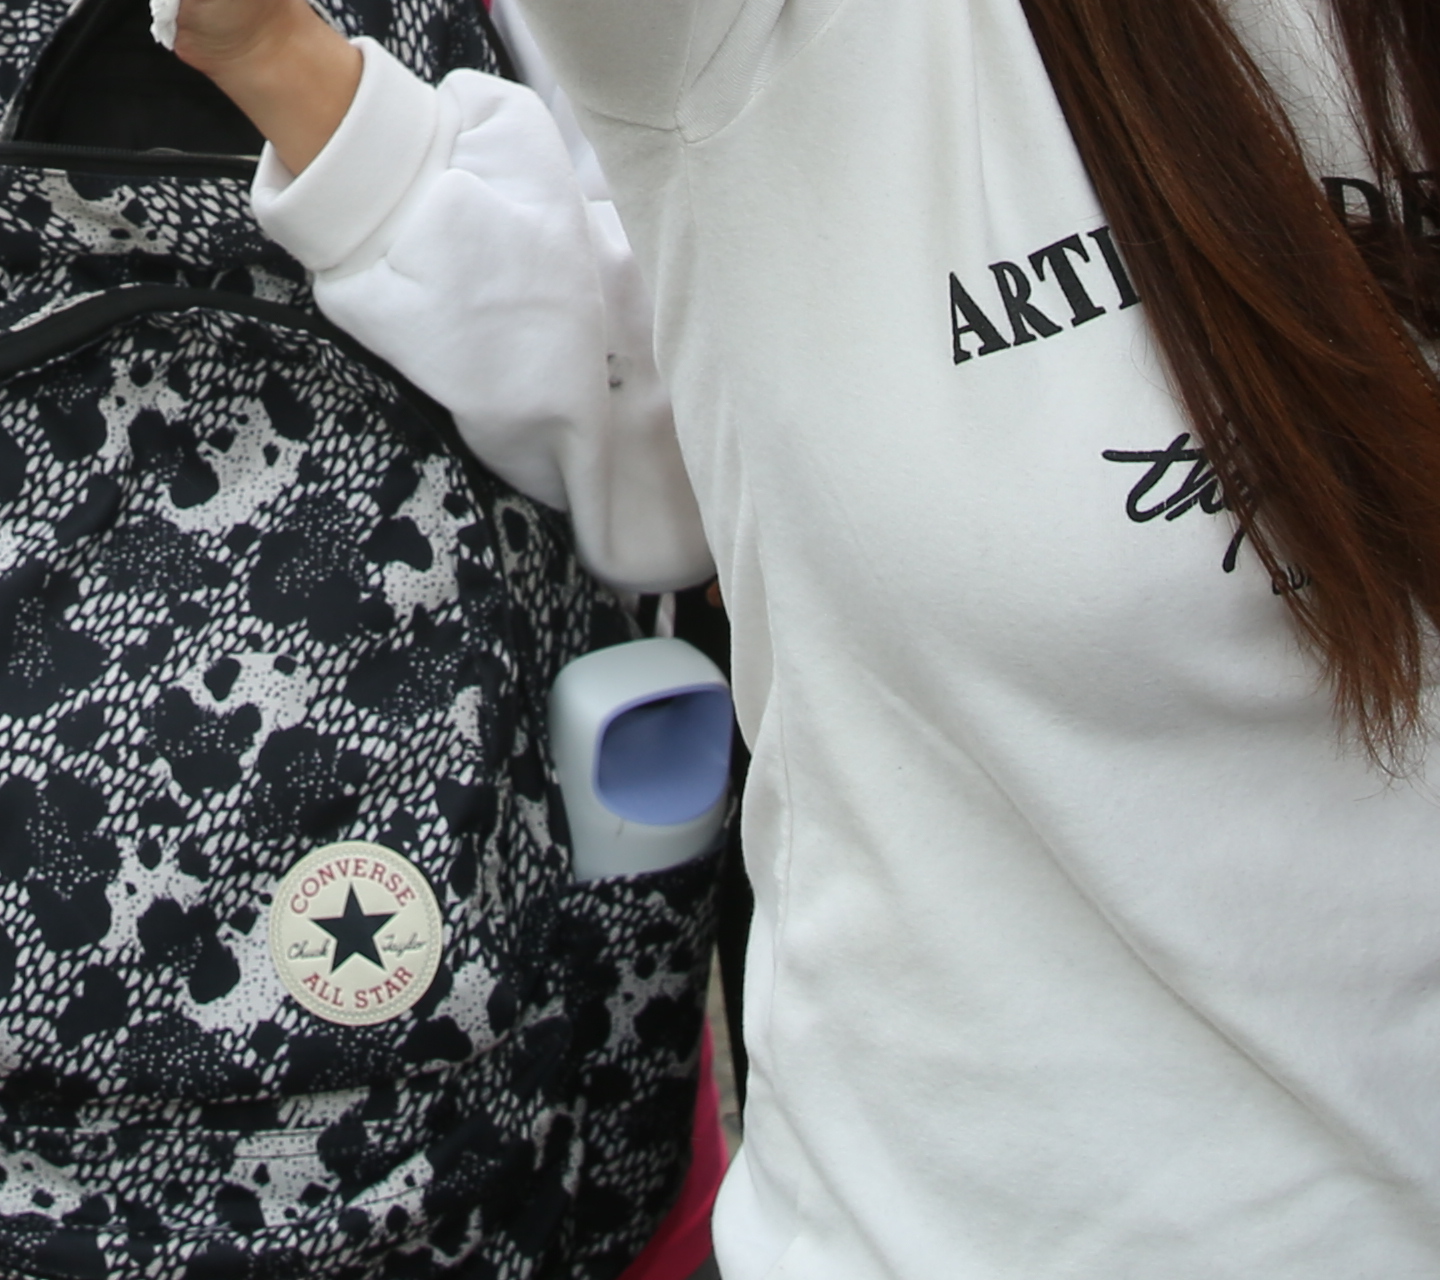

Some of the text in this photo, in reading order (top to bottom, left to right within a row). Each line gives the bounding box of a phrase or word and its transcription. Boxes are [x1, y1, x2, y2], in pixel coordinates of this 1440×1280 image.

[290, 858, 417, 915] CONVERSE
[302, 966, 414, 1009] ALL STAR
